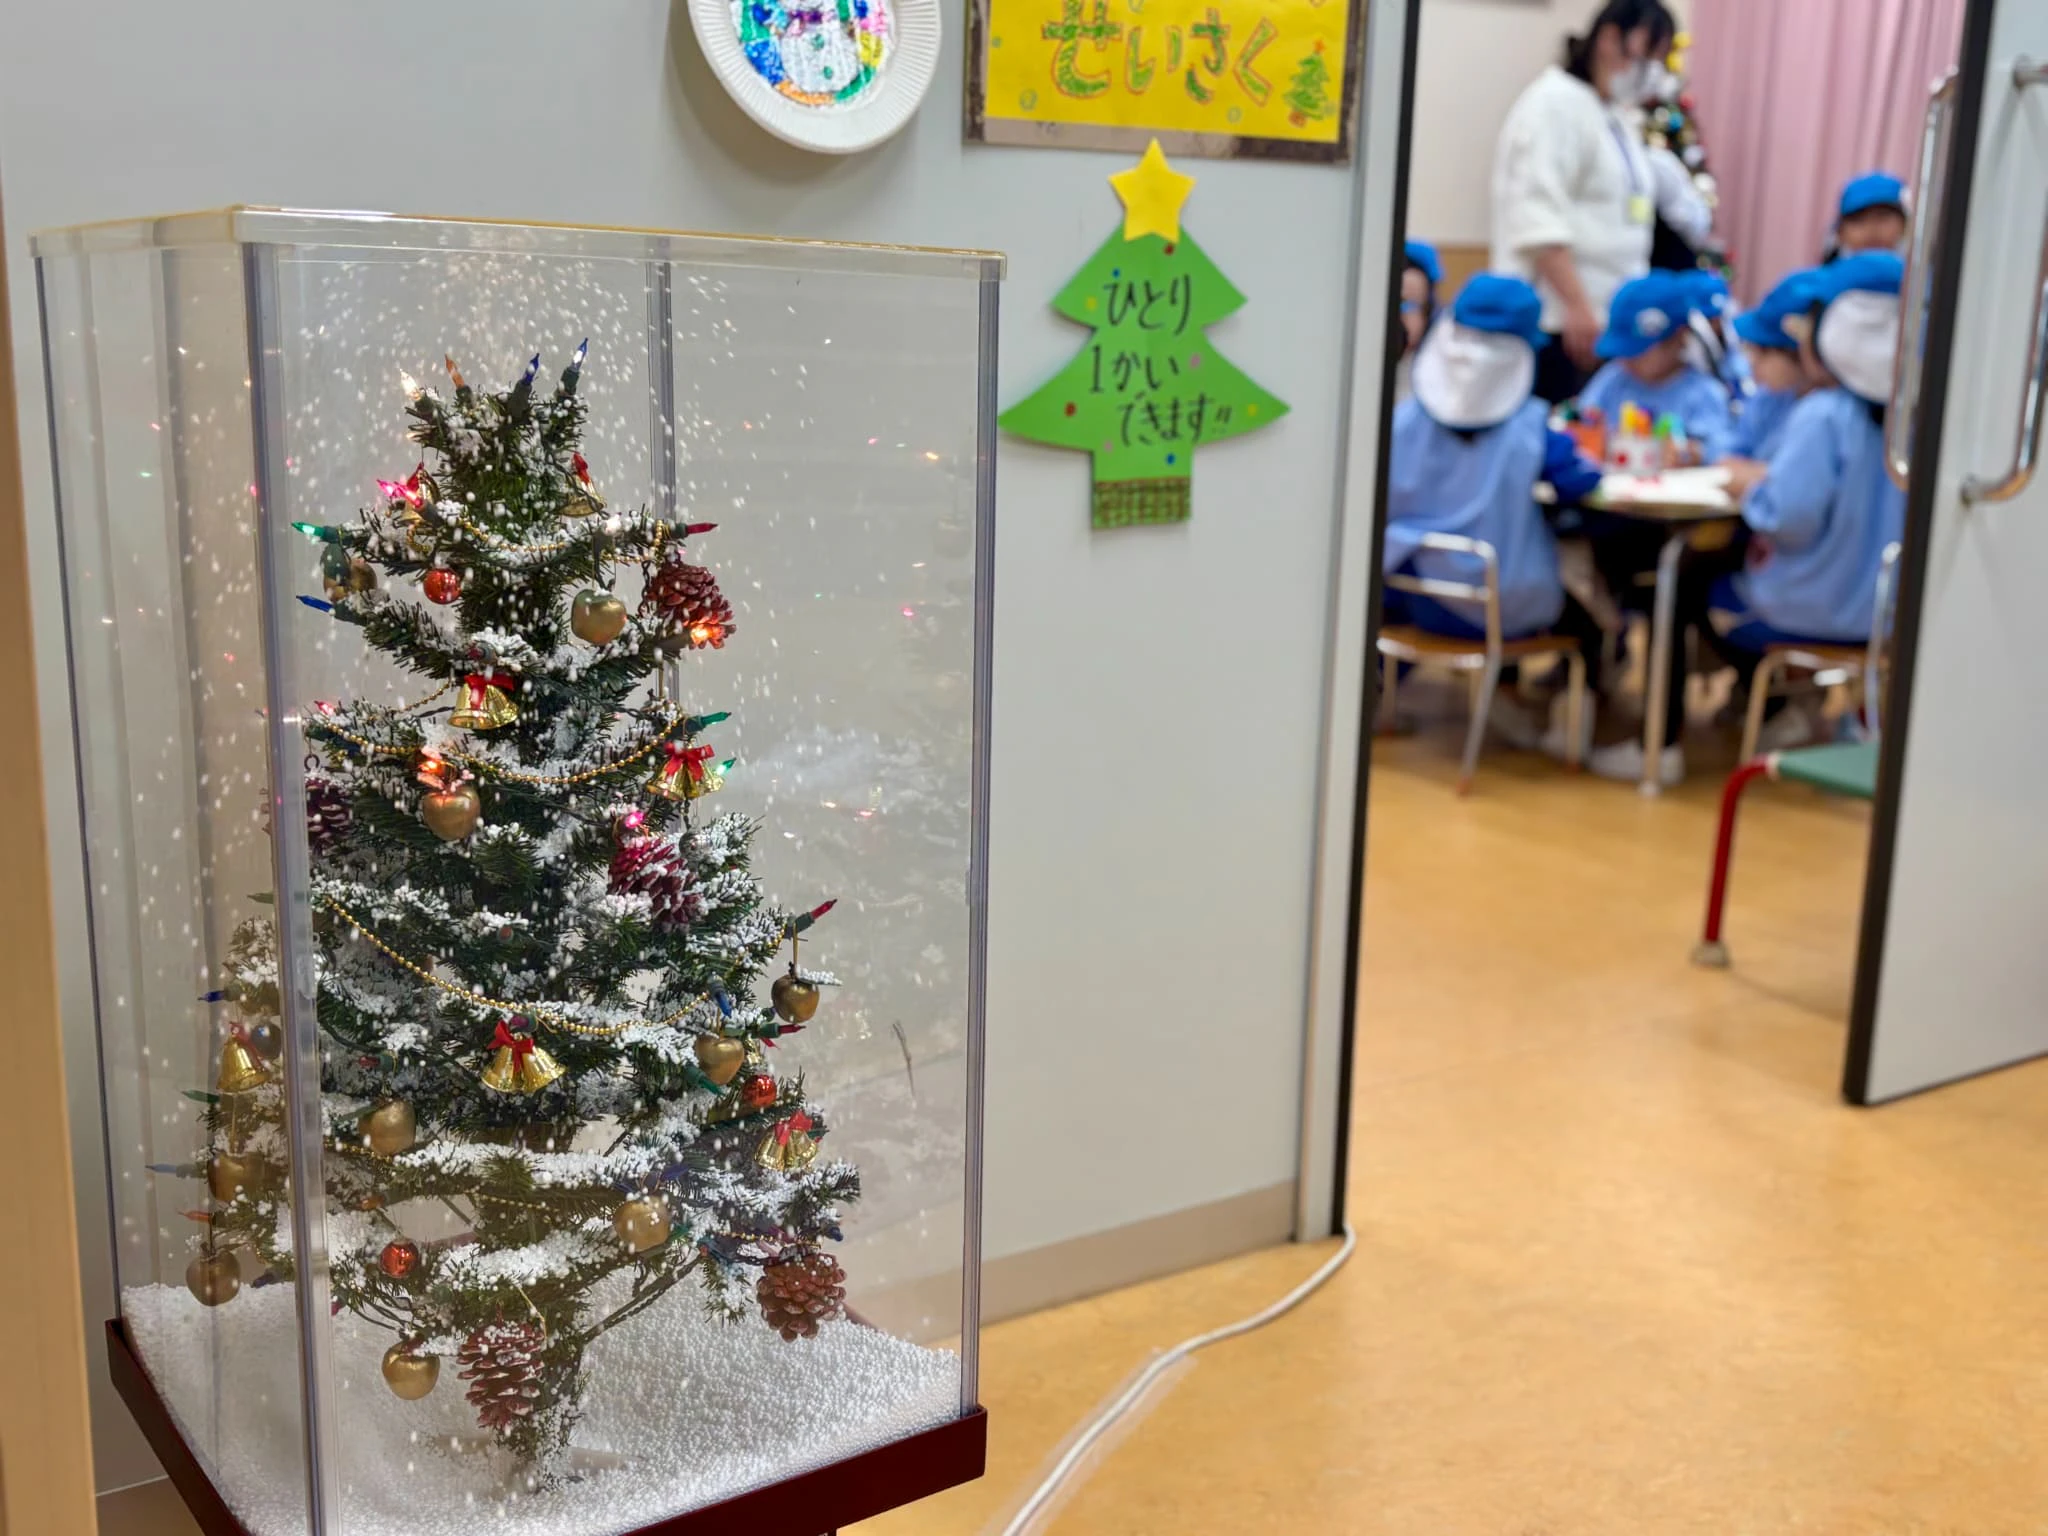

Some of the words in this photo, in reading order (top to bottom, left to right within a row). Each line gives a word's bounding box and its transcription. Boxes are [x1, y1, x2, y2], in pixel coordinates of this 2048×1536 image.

[1042, 0, 1278, 107] せいさく
[1103, 274, 1191, 336] ひとり
